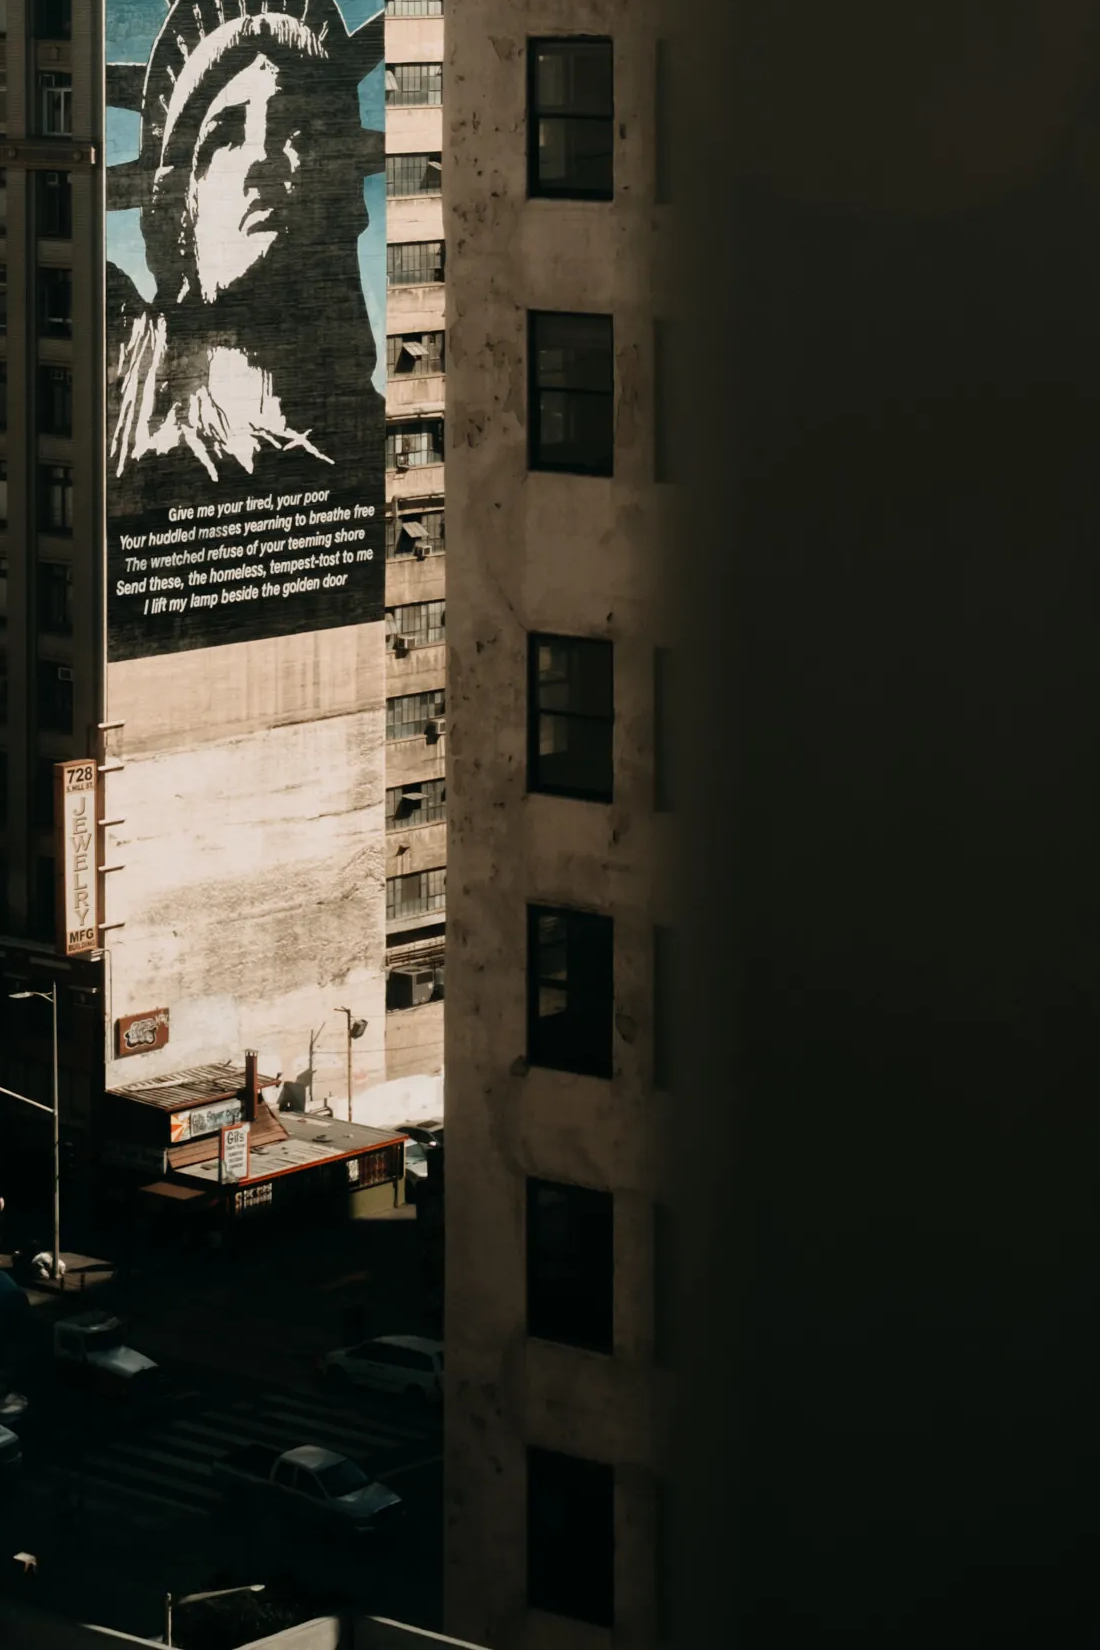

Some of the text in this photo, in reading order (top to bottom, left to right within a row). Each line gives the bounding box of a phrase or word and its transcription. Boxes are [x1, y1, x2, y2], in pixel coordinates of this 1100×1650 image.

[168, 490, 330, 522] Give me your tired, your poor
[120, 504, 375, 550] Your huddled masses yearning to breathe free
[125, 528, 366, 572] The wretched refuse of your teeming shore
[116, 548, 374, 596] Send these, the homeless, tempest-tost to me
[143, 573, 348, 615] I lift my lamp beside the golden door
[66, 766, 93, 784] 728
[71, 797, 92, 926] JEWELRY
[68, 940, 96, 952] BUILDING
[70, 928, 93, 943] MFG
[227, 1130, 245, 1145] Gil's
